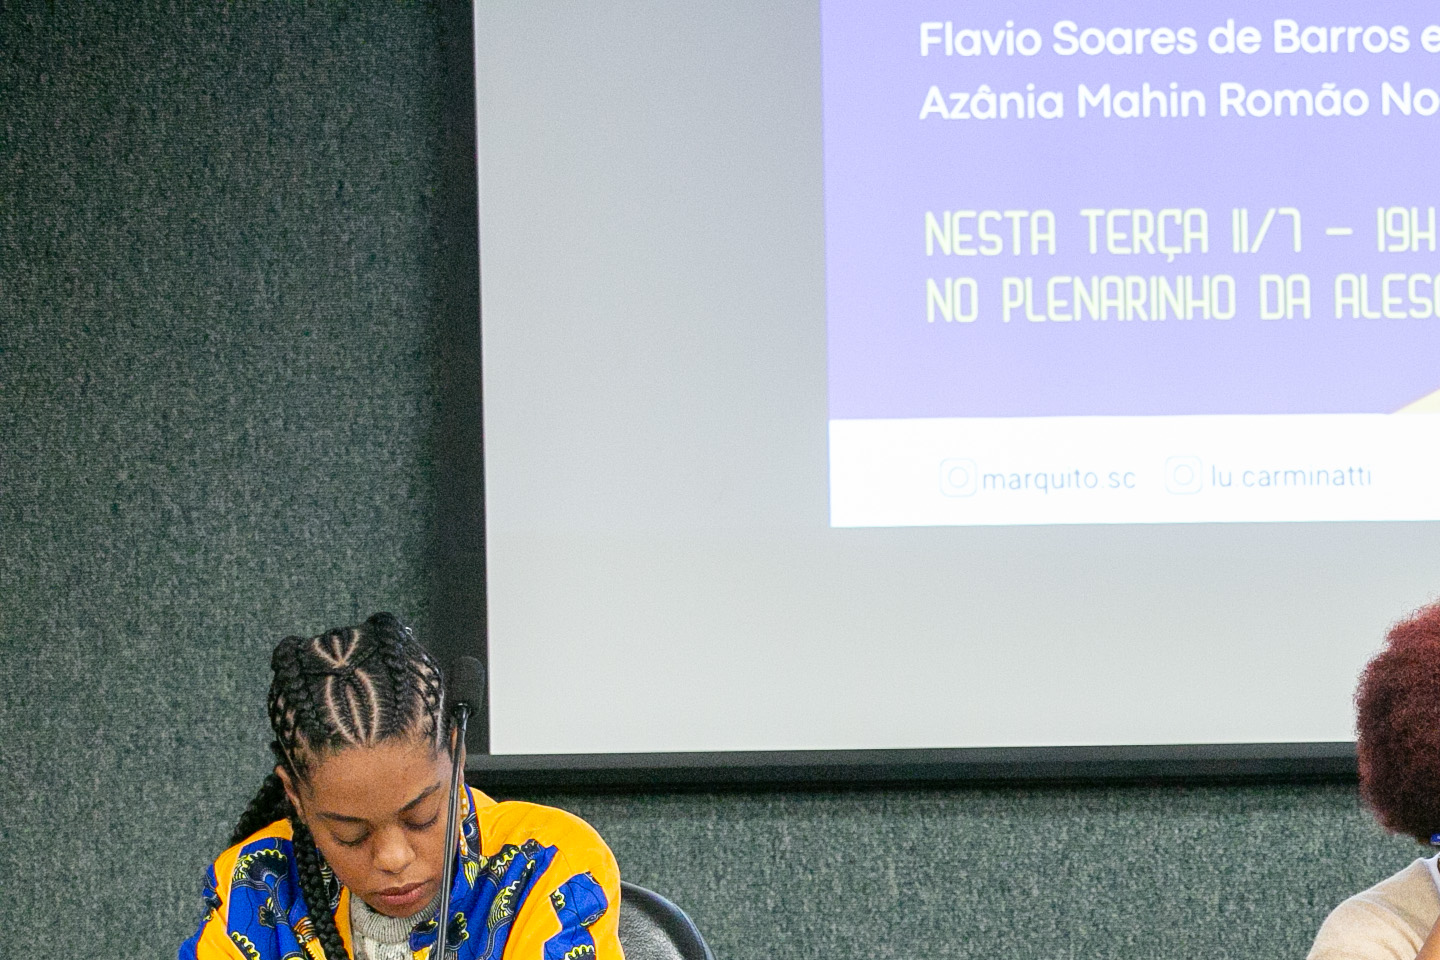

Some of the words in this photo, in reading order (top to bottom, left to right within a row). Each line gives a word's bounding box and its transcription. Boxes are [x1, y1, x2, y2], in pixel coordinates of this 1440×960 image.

[920, 20, 1043, 57] Flavio
[1053, 21, 1199, 56] Soares
[1208, 19, 1263, 55] de
[1274, 20, 1412, 54] Barros
[919, 83, 1065, 120] Azânia
[1078, 82, 1207, 119] Mahin
[1220, 82, 1371, 118] Romão
[925, 210, 1057, 256] NESTA
[1080, 208, 1210, 263] TERÇA
[1377, 207, 1437, 253] 19H
[926, 278, 980, 323] NO
[1002, 275, 1237, 323] PLENARINHO
[1260, 274, 1312, 320] DA
[983, 469, 1137, 496] marquito.sc
[1212, 464, 1373, 489] lu.carminatti
